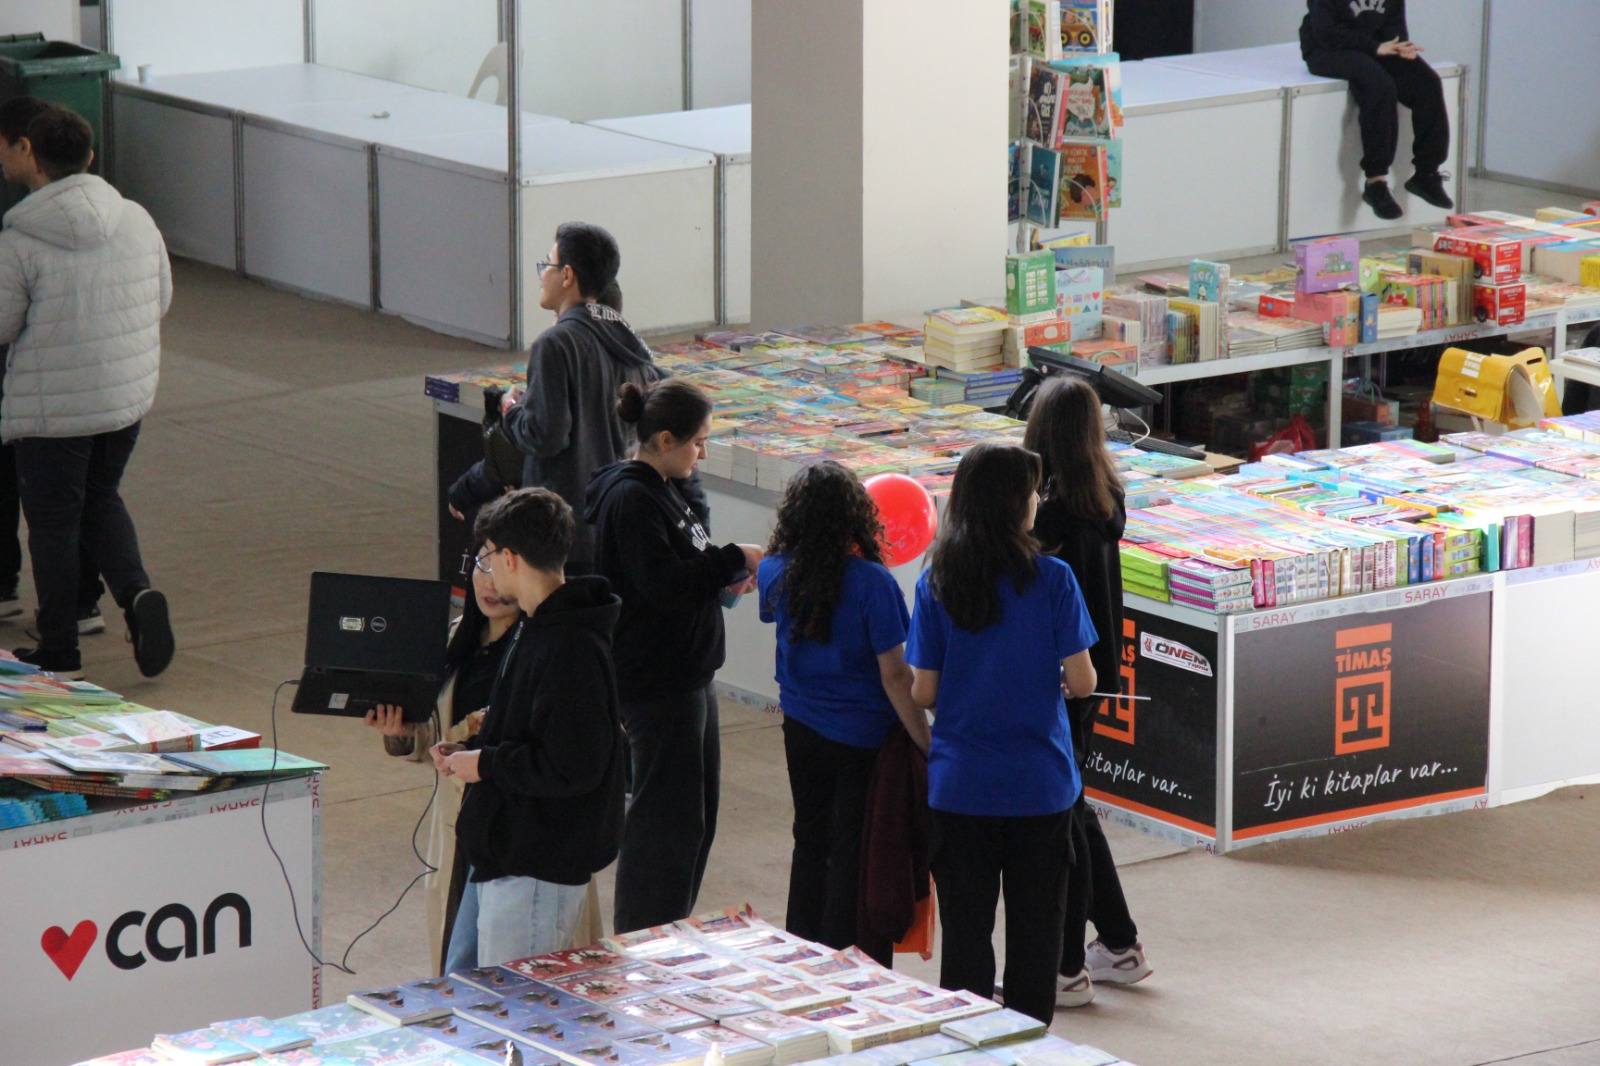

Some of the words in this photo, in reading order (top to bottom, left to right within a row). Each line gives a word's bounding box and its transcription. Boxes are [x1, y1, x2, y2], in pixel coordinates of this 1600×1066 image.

[1404, 587, 1448, 603] SARAY
[1253, 613, 1297, 629] SARAY
[1155, 642, 1208, 667] ÖNEM
[1335, 648, 1392, 673] TİMAŞ
[1152, 775, 1193, 800] var...
[1264, 774, 1294, 812] İyi
[1301, 776, 1319, 800] ki
[1324, 763, 1402, 795] kitaplar
[1409, 760, 1459, 780] var...
[105, 892, 252, 971] can
